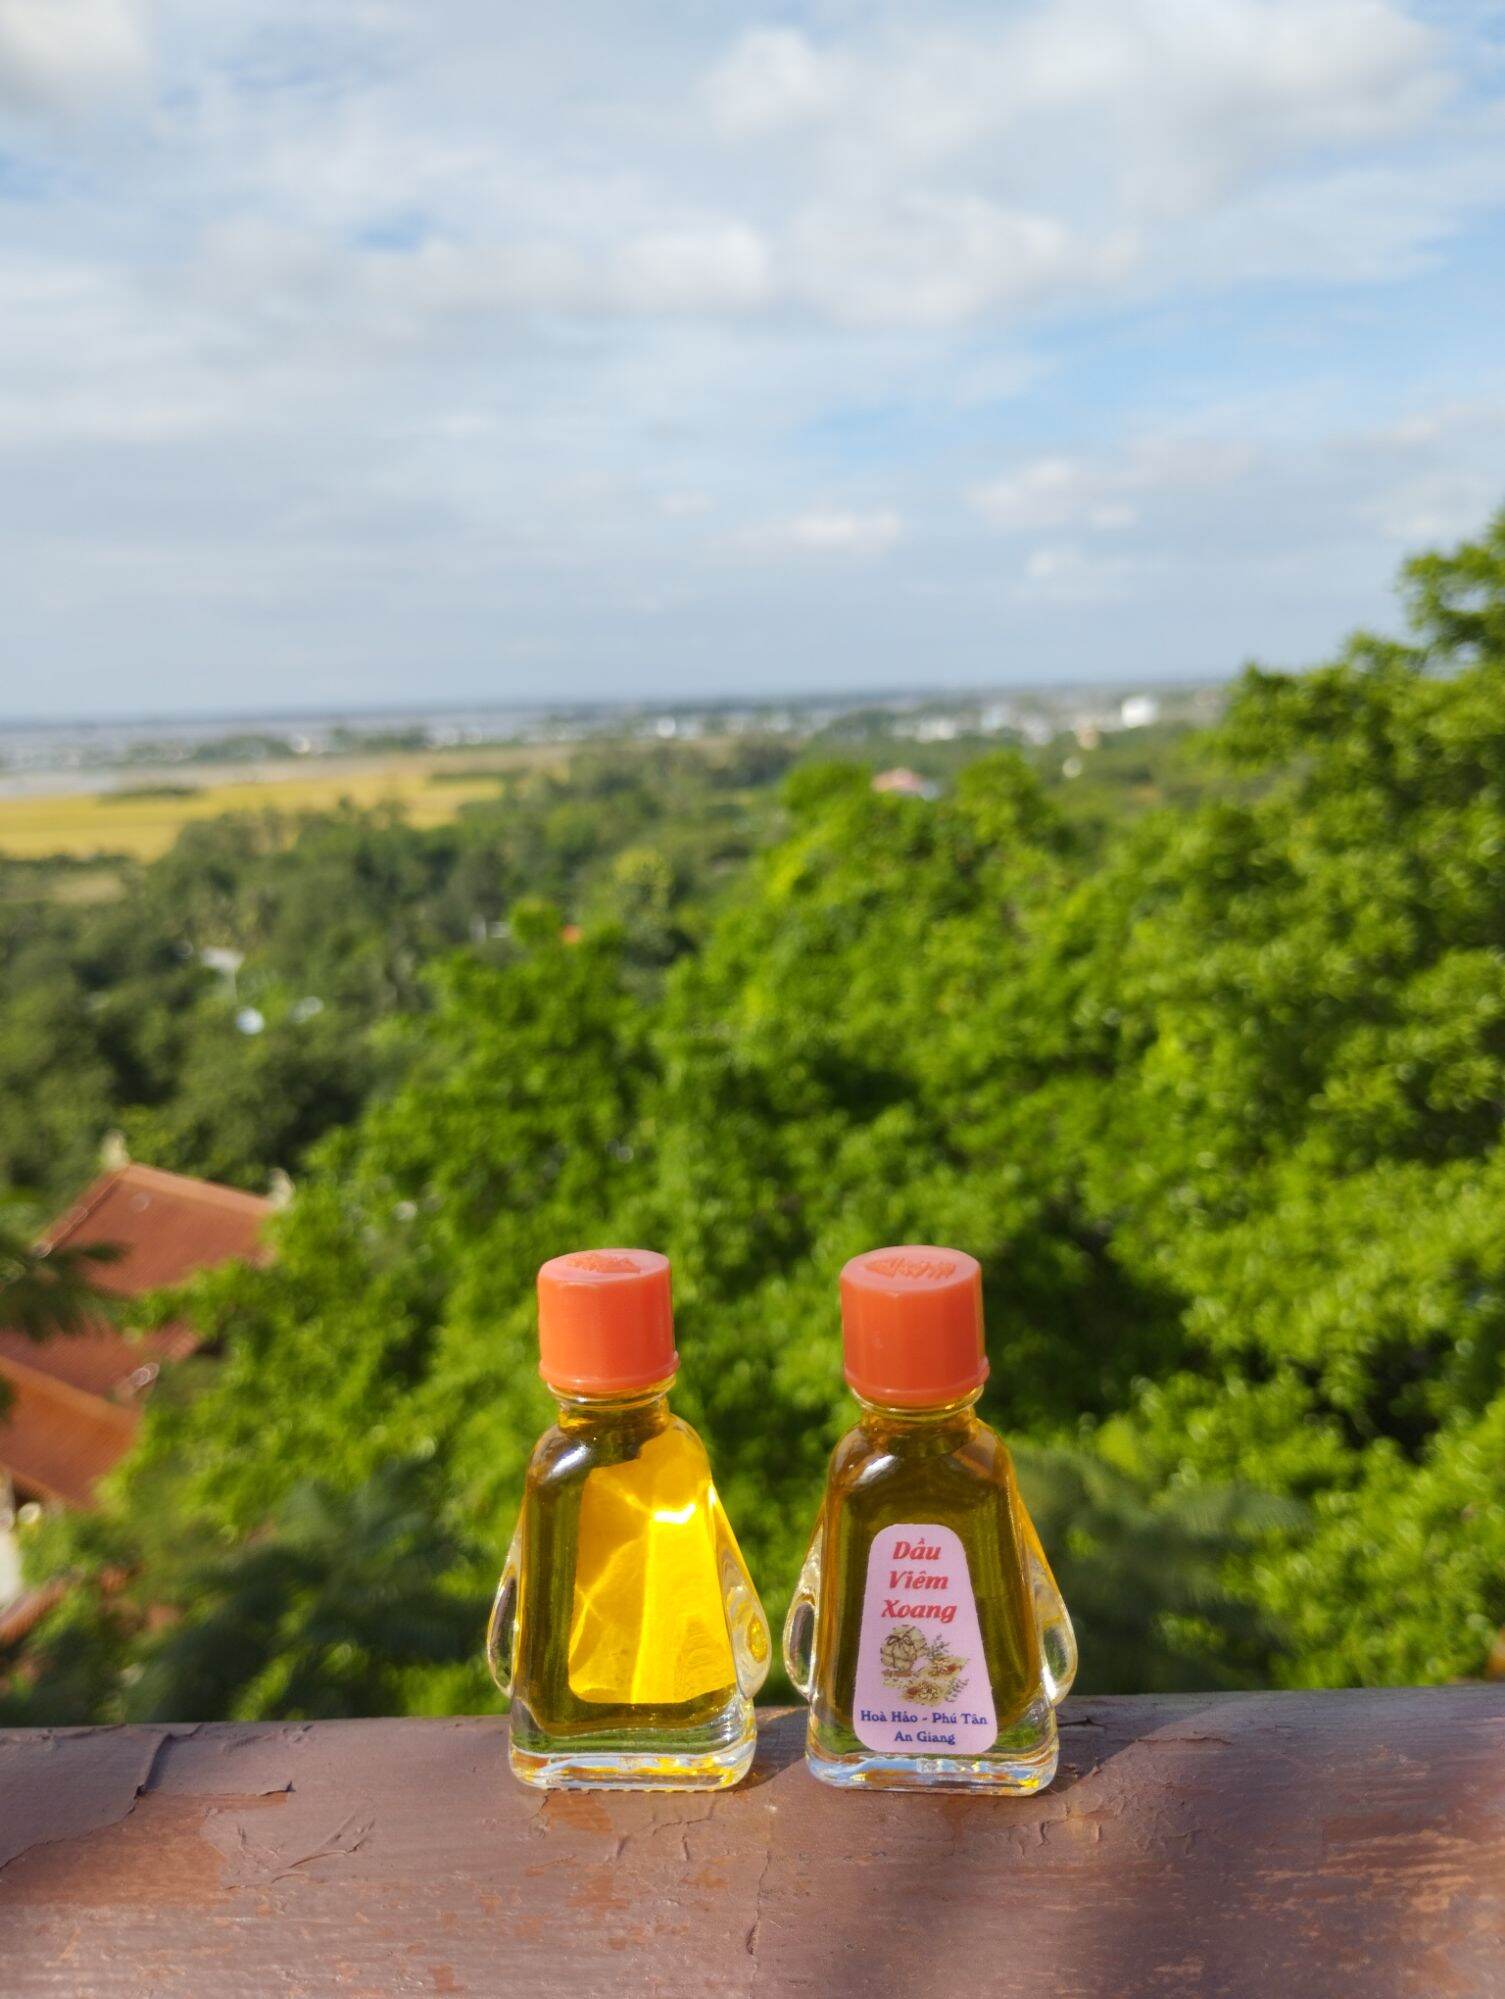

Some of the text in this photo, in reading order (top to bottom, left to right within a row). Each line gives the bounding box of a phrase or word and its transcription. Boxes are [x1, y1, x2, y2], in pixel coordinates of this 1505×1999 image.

[893, 1537, 941, 1560] Dầu
[888, 1570, 949, 1590] Viêm
[881, 1599, 958, 1624] Xoang
[860, 1710, 887, 1722] Hoà
[891, 1710, 918, 1723] Hảo
[932, 1712, 957, 1724] Phú
[961, 1713, 988, 1725] Tân
[894, 1730, 956, 1745] An Giang
